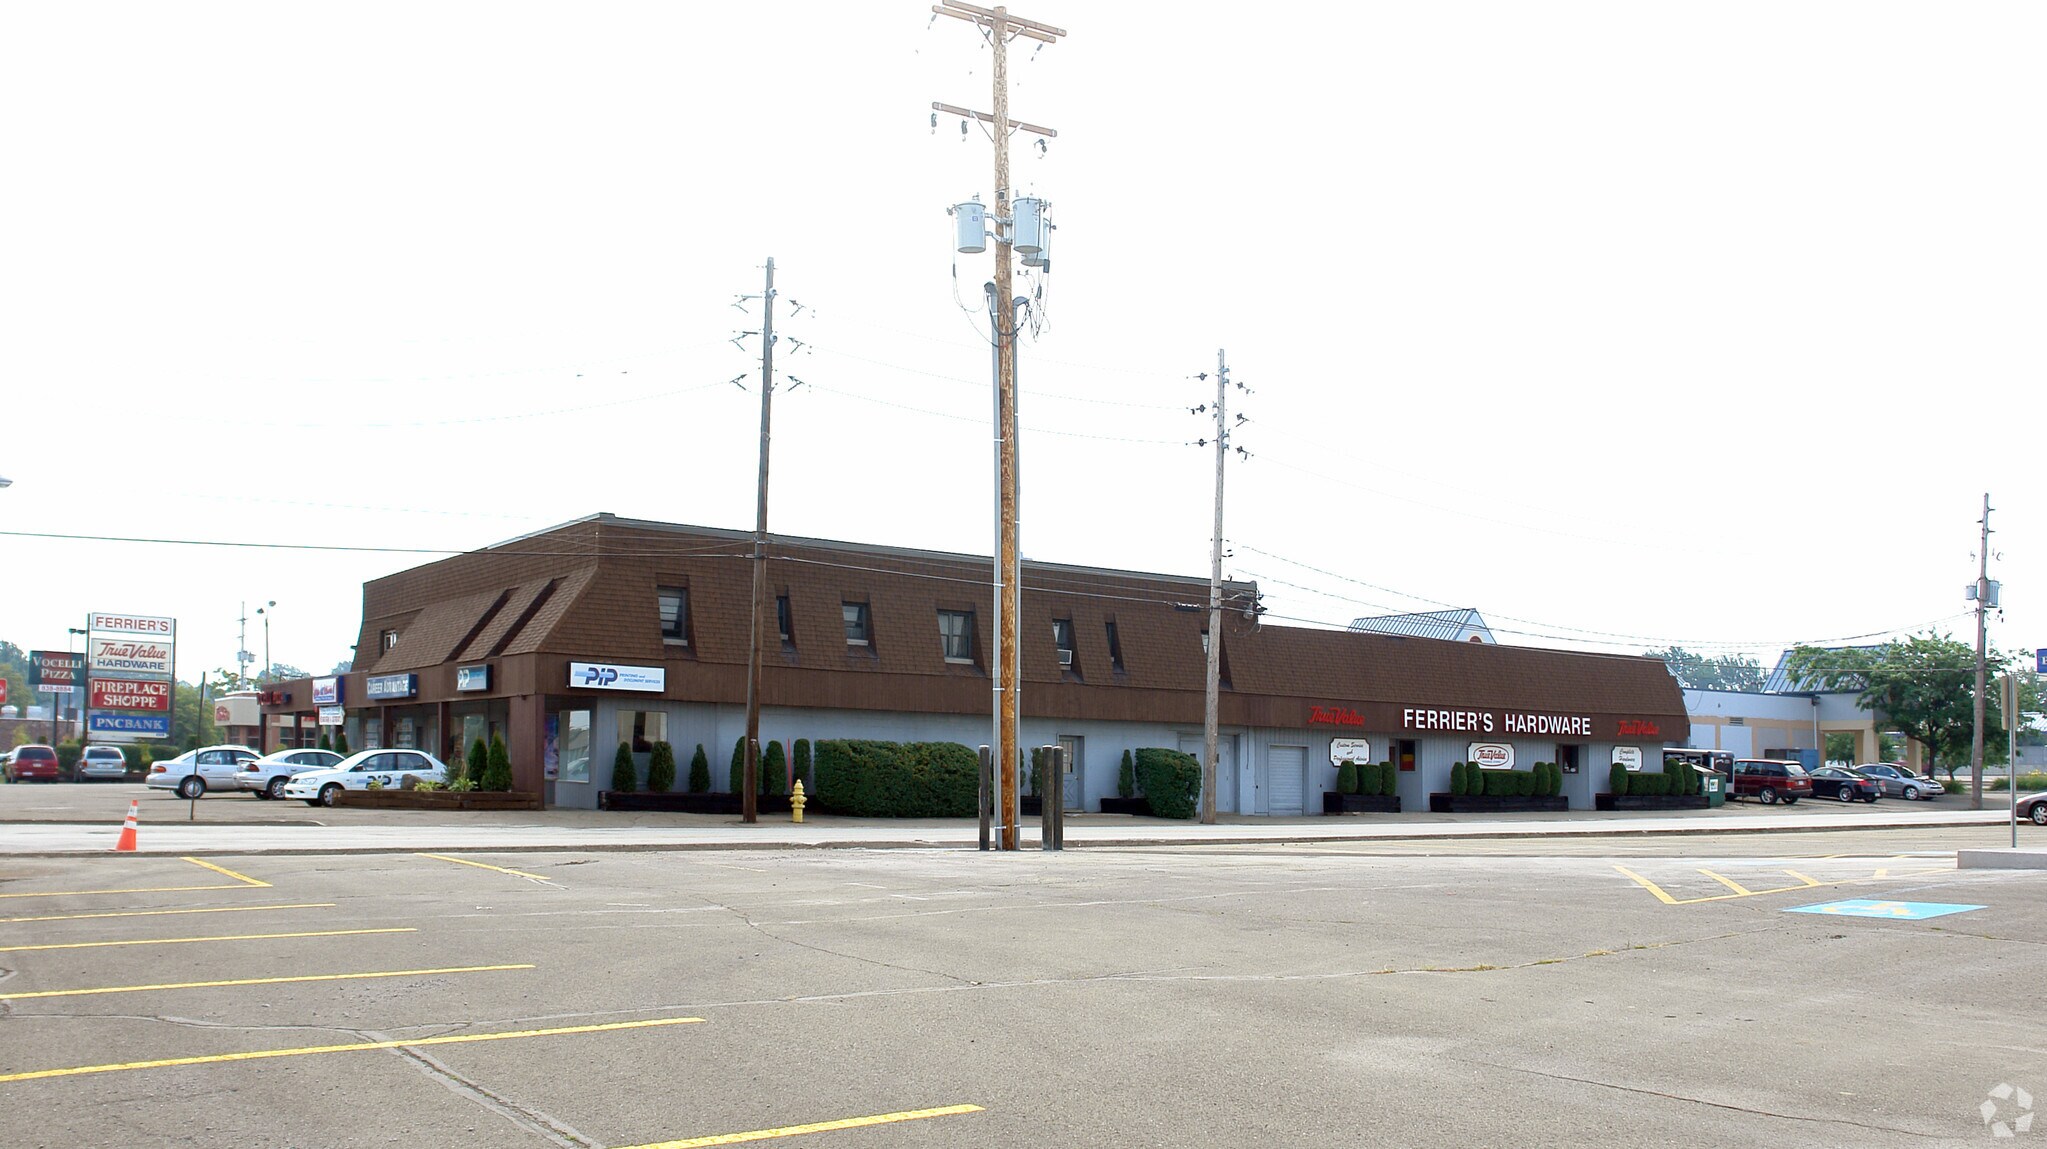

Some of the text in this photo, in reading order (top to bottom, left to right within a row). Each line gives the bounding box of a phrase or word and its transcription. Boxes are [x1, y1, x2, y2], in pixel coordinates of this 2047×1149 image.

[95, 616, 169, 632] FERRIER'S
[97, 642, 167, 659] True Value
[32, 656, 82, 669] VOCELLI
[97, 659, 165, 670] HARDWARE
[41, 668, 76, 680] PIZZA
[93, 681, 167, 696] FIREPLACE
[366, 681, 383, 695] CAREER
[103, 694, 157, 708] SHOPPE
[1307, 705, 1366, 726] True Value
[1403, 708, 1592, 736] FERRIER'S HARDWARE
[1616, 720, 1660, 737] True Value
[1477, 749, 1506, 761] True Value
[365, 774, 392, 789] PP
